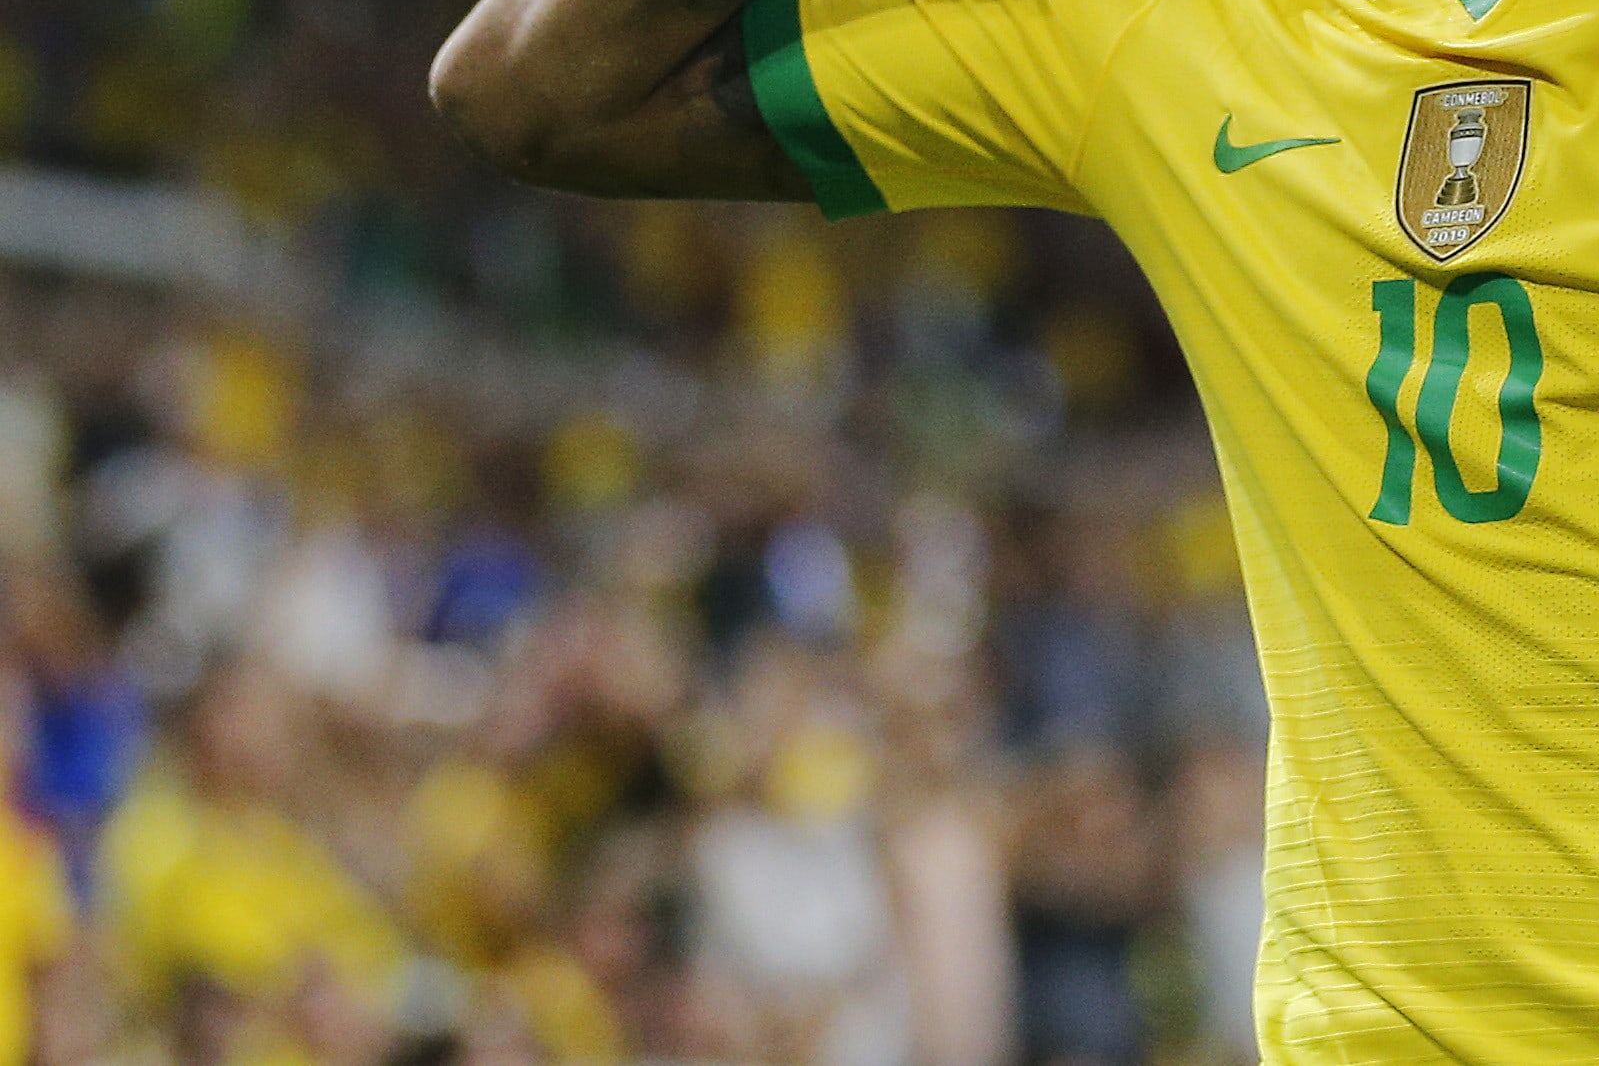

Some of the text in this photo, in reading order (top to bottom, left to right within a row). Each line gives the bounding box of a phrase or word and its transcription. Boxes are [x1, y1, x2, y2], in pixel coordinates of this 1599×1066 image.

[1444, 91, 1501, 107] CONMEBOL
[1429, 229, 1468, 244] 2019
[1366, 272, 1544, 526] 10
